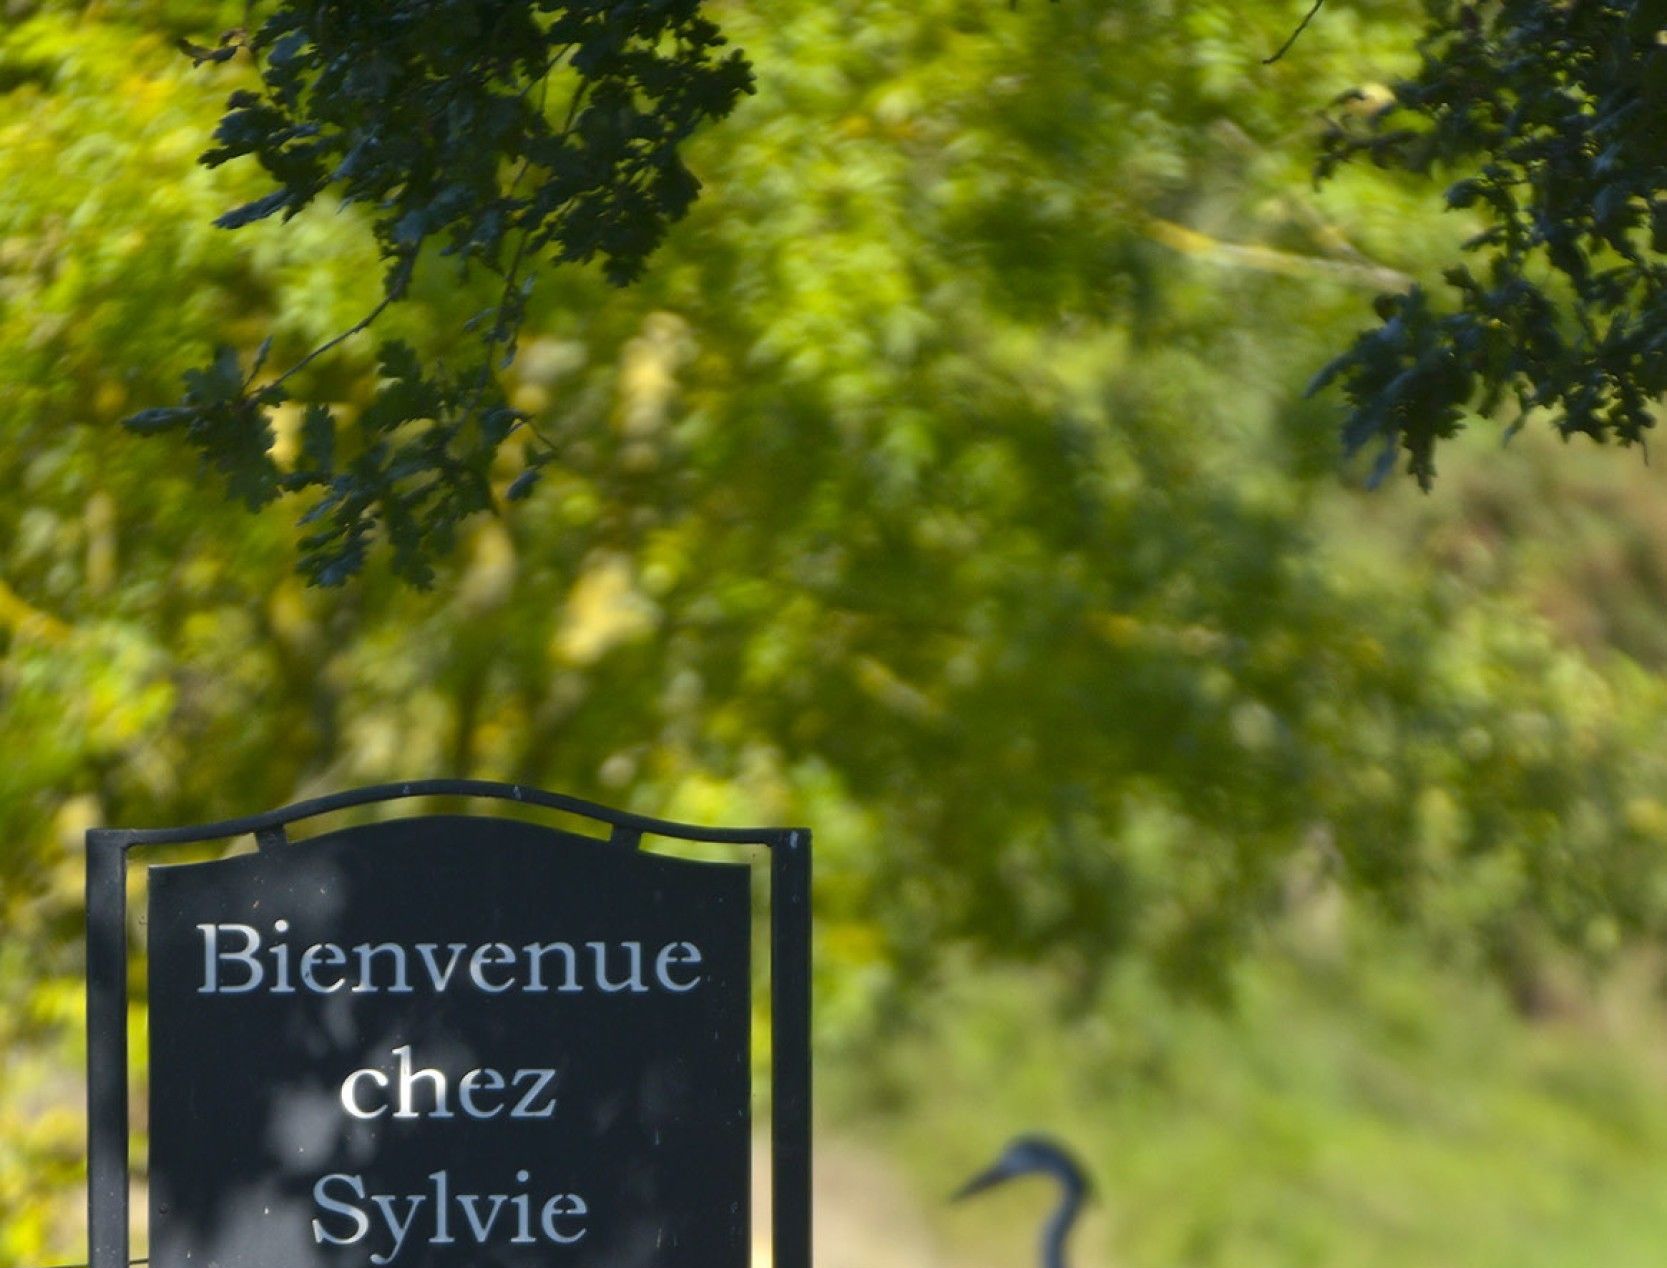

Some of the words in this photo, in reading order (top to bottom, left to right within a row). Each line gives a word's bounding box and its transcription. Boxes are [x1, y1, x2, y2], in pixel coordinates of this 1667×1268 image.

[195, 919, 702, 994] Bienvenue
[340, 1044, 557, 1120] chez
[311, 1170, 588, 1266] Sylvie
